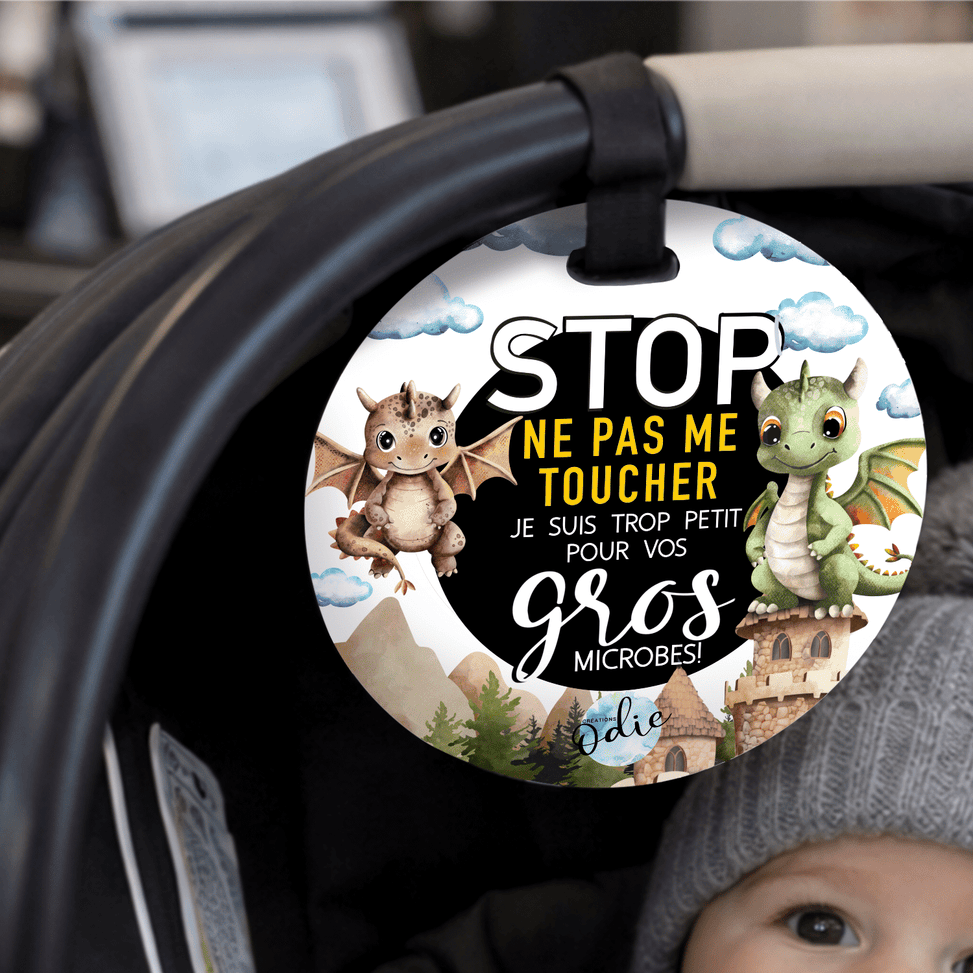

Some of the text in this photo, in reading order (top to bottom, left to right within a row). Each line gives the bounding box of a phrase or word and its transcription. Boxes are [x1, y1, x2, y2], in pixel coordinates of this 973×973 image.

[487, 312, 785, 414] STOP
[523, 412, 738, 459] NE PAS ME
[538, 461, 717, 507] TOUCHER
[510, 507, 743, 538] JE SUIS TROP PETIT
[566, 537, 687, 563] POUR VOS
[512, 567, 736, 683] gros
[574, 641, 702, 672] MICROBES!
[571, 696, 673, 756] Odie
